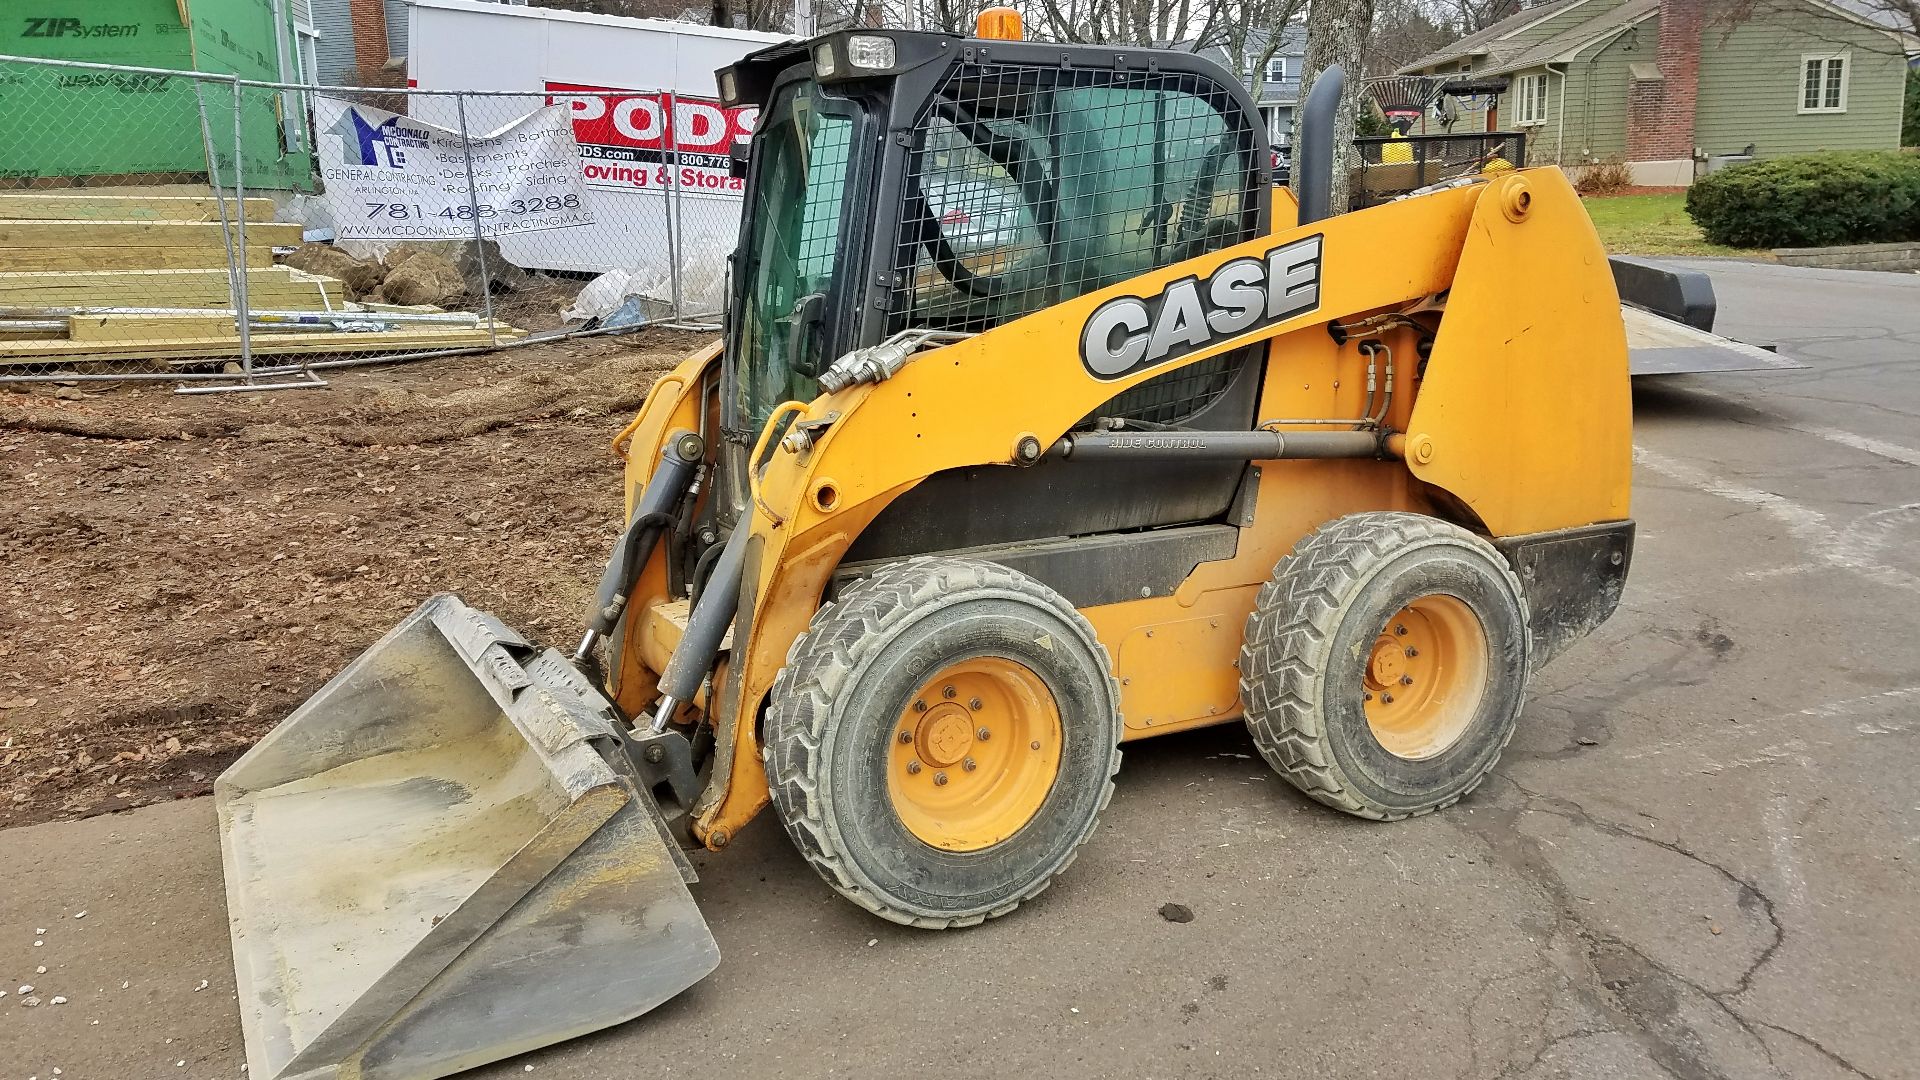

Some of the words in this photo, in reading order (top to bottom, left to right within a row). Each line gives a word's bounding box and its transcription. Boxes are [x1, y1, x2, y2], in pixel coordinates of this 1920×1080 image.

[507, 159, 568, 175] Porches
[580, 160, 647, 186] oving
[655, 166, 672, 185] &
[326, 168, 375, 181] GENERAL
[377, 170, 436, 186] CONTRACTING
[525, 173, 567, 187] Siding
[365, 193, 580, 220] 781-488-3288
[1084, 239, 1321, 376] CASE
[1108, 438, 1142, 449] RIDE
[1145, 438, 1207, 449] CONTROL
